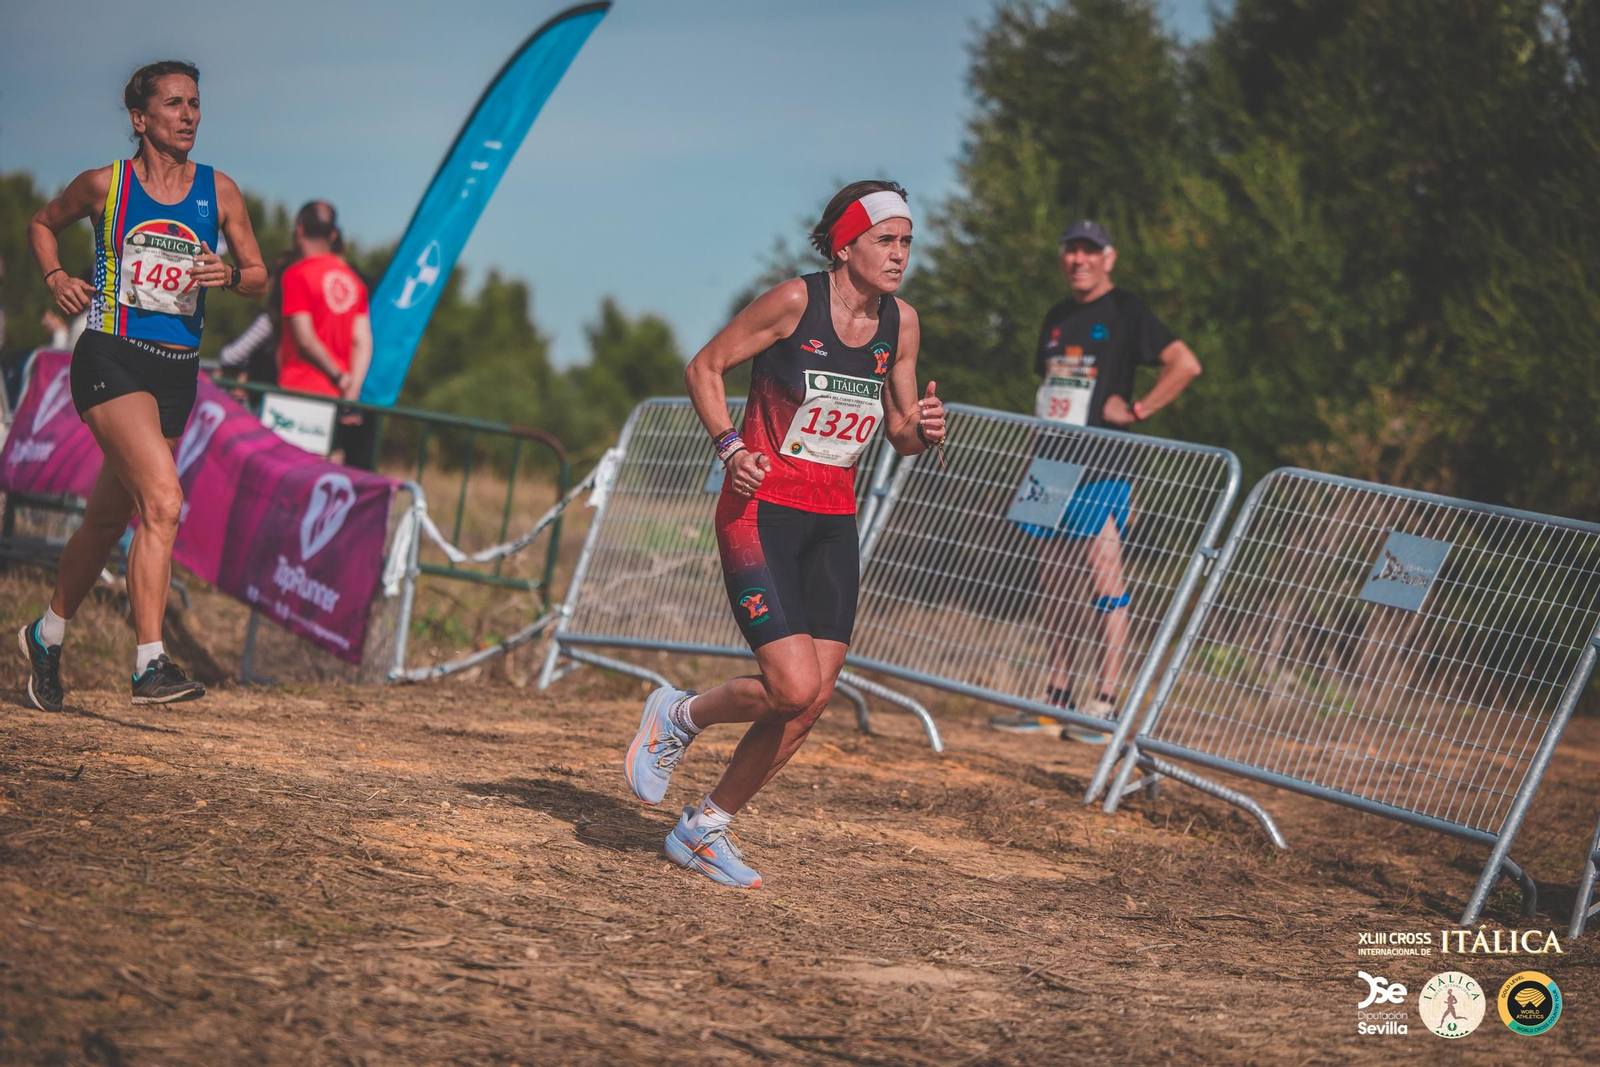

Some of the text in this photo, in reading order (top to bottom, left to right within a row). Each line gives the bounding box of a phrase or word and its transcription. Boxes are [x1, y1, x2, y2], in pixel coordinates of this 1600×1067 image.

[150, 237, 189, 253] ITÁLICA
[833, 379, 870, 395] ITÁLICA
[801, 407, 876, 443] 1320
[273, 555, 340, 613] TopRunner
